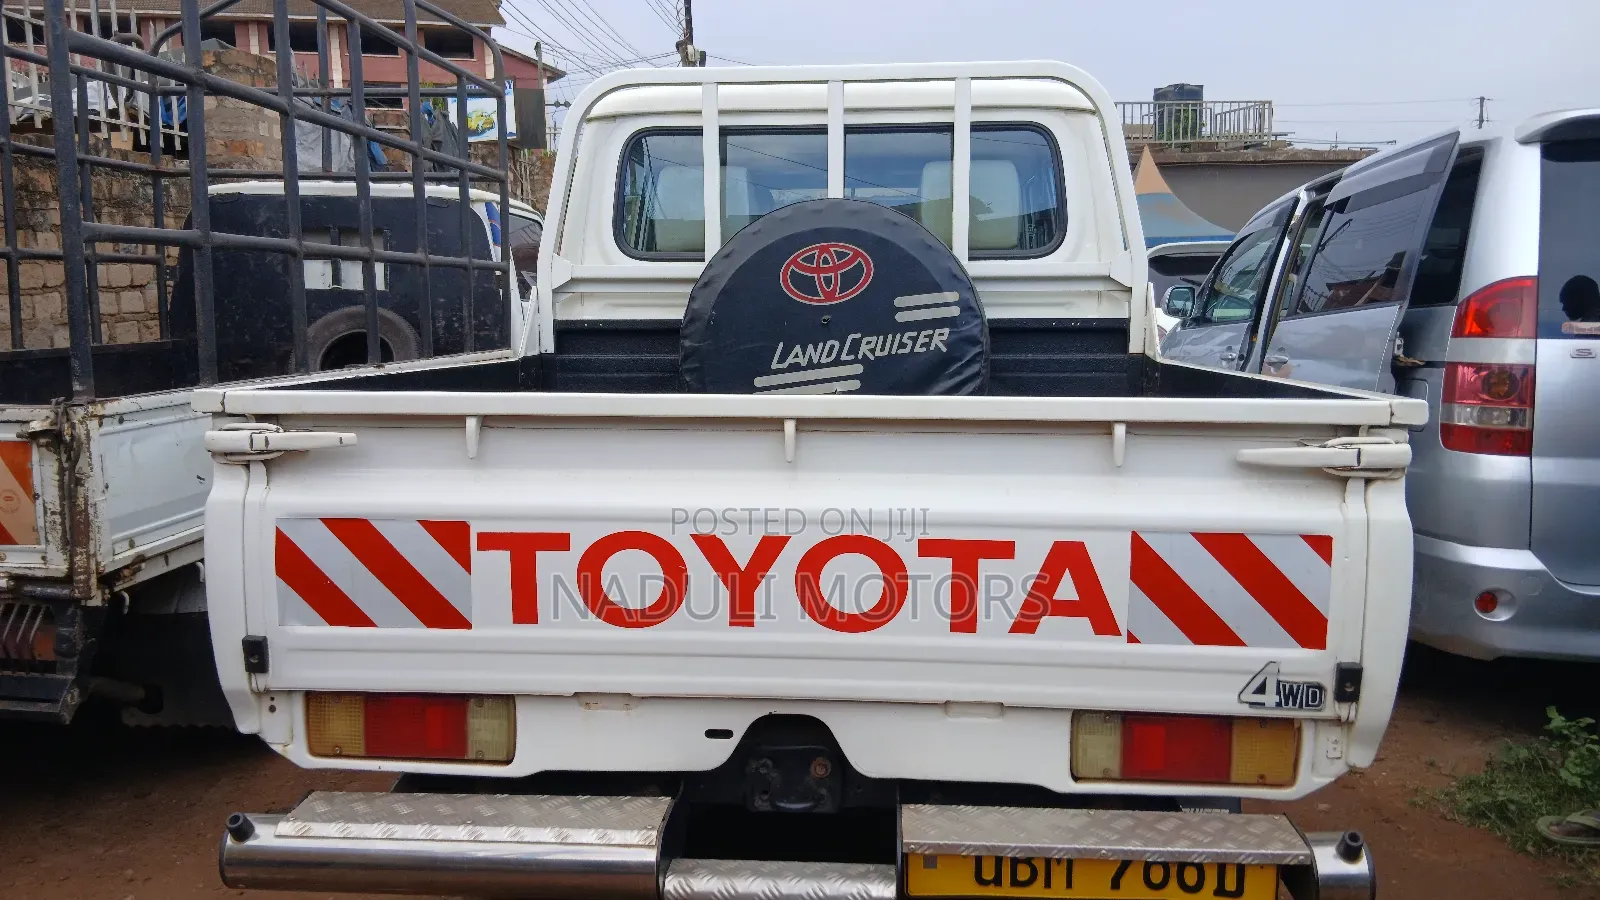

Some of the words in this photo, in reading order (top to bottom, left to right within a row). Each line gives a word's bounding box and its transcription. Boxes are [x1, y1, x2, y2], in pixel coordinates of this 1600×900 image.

[771, 340, 841, 369] LAND
[840, 327, 950, 361] CRUISER
[476, 529, 1123, 636] TOYOTA
[1238, 660, 1327, 710] 4WD
